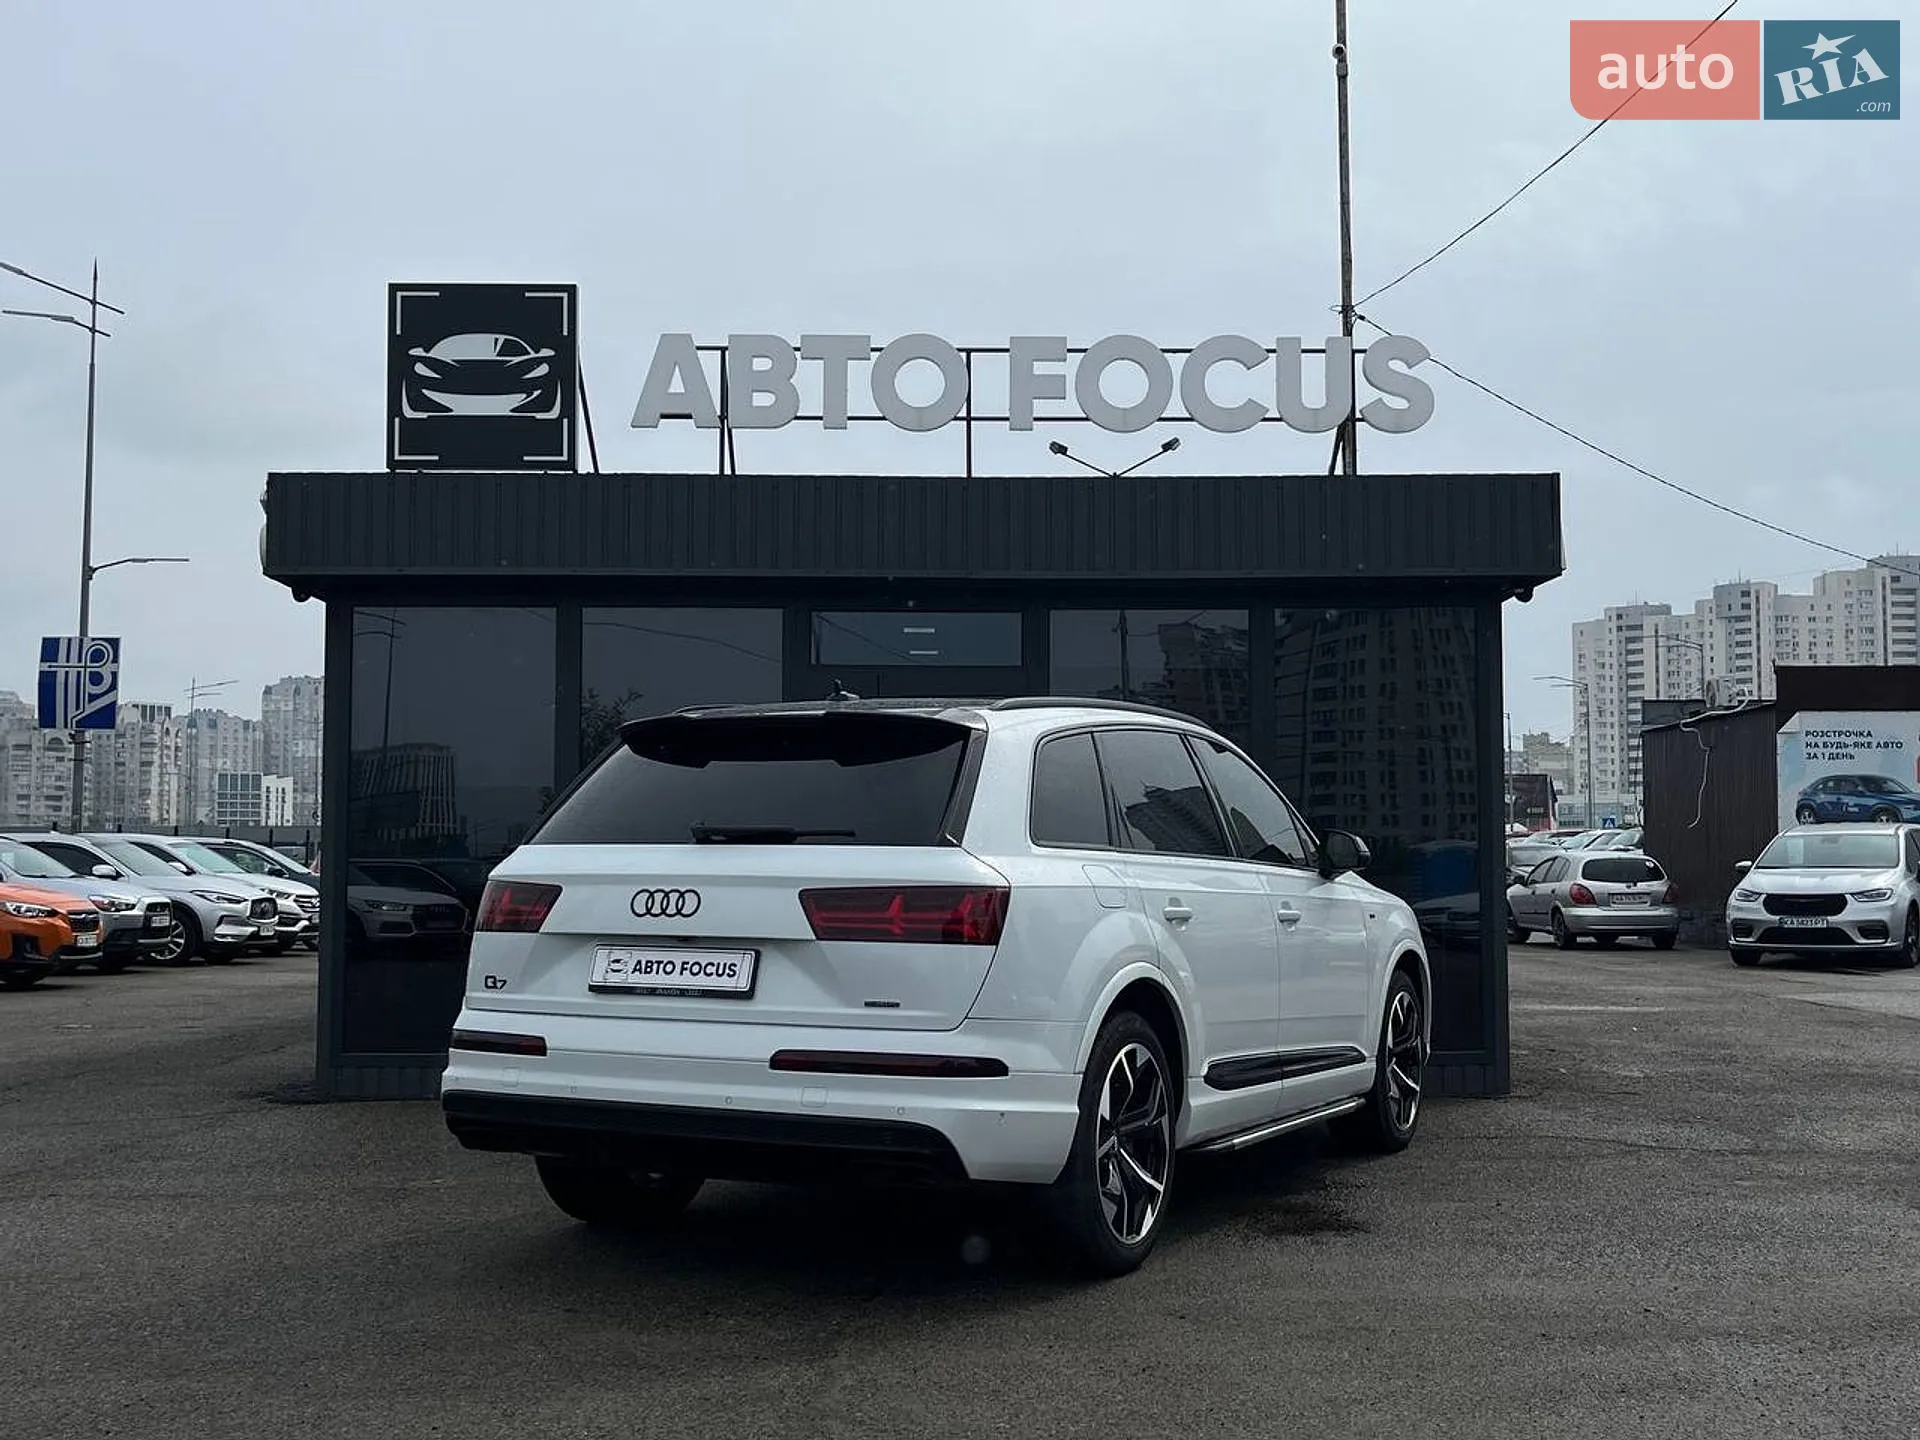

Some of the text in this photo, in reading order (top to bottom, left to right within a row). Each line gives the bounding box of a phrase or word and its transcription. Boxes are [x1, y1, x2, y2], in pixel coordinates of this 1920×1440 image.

[631, 333, 1435, 433] АВТО FOCUS
[1804, 730, 1873, 738] РОЗСТРОЧКА
[1805, 741, 1904, 750] НА БУДЬ-ЯКЕ АВТО
[1806, 752, 1819, 760] ЗА
[1827, 752, 1855, 761] ДЕНЬ
[631, 959, 738, 979] АВТО FOCUS
[484, 974, 507, 990] Q7
